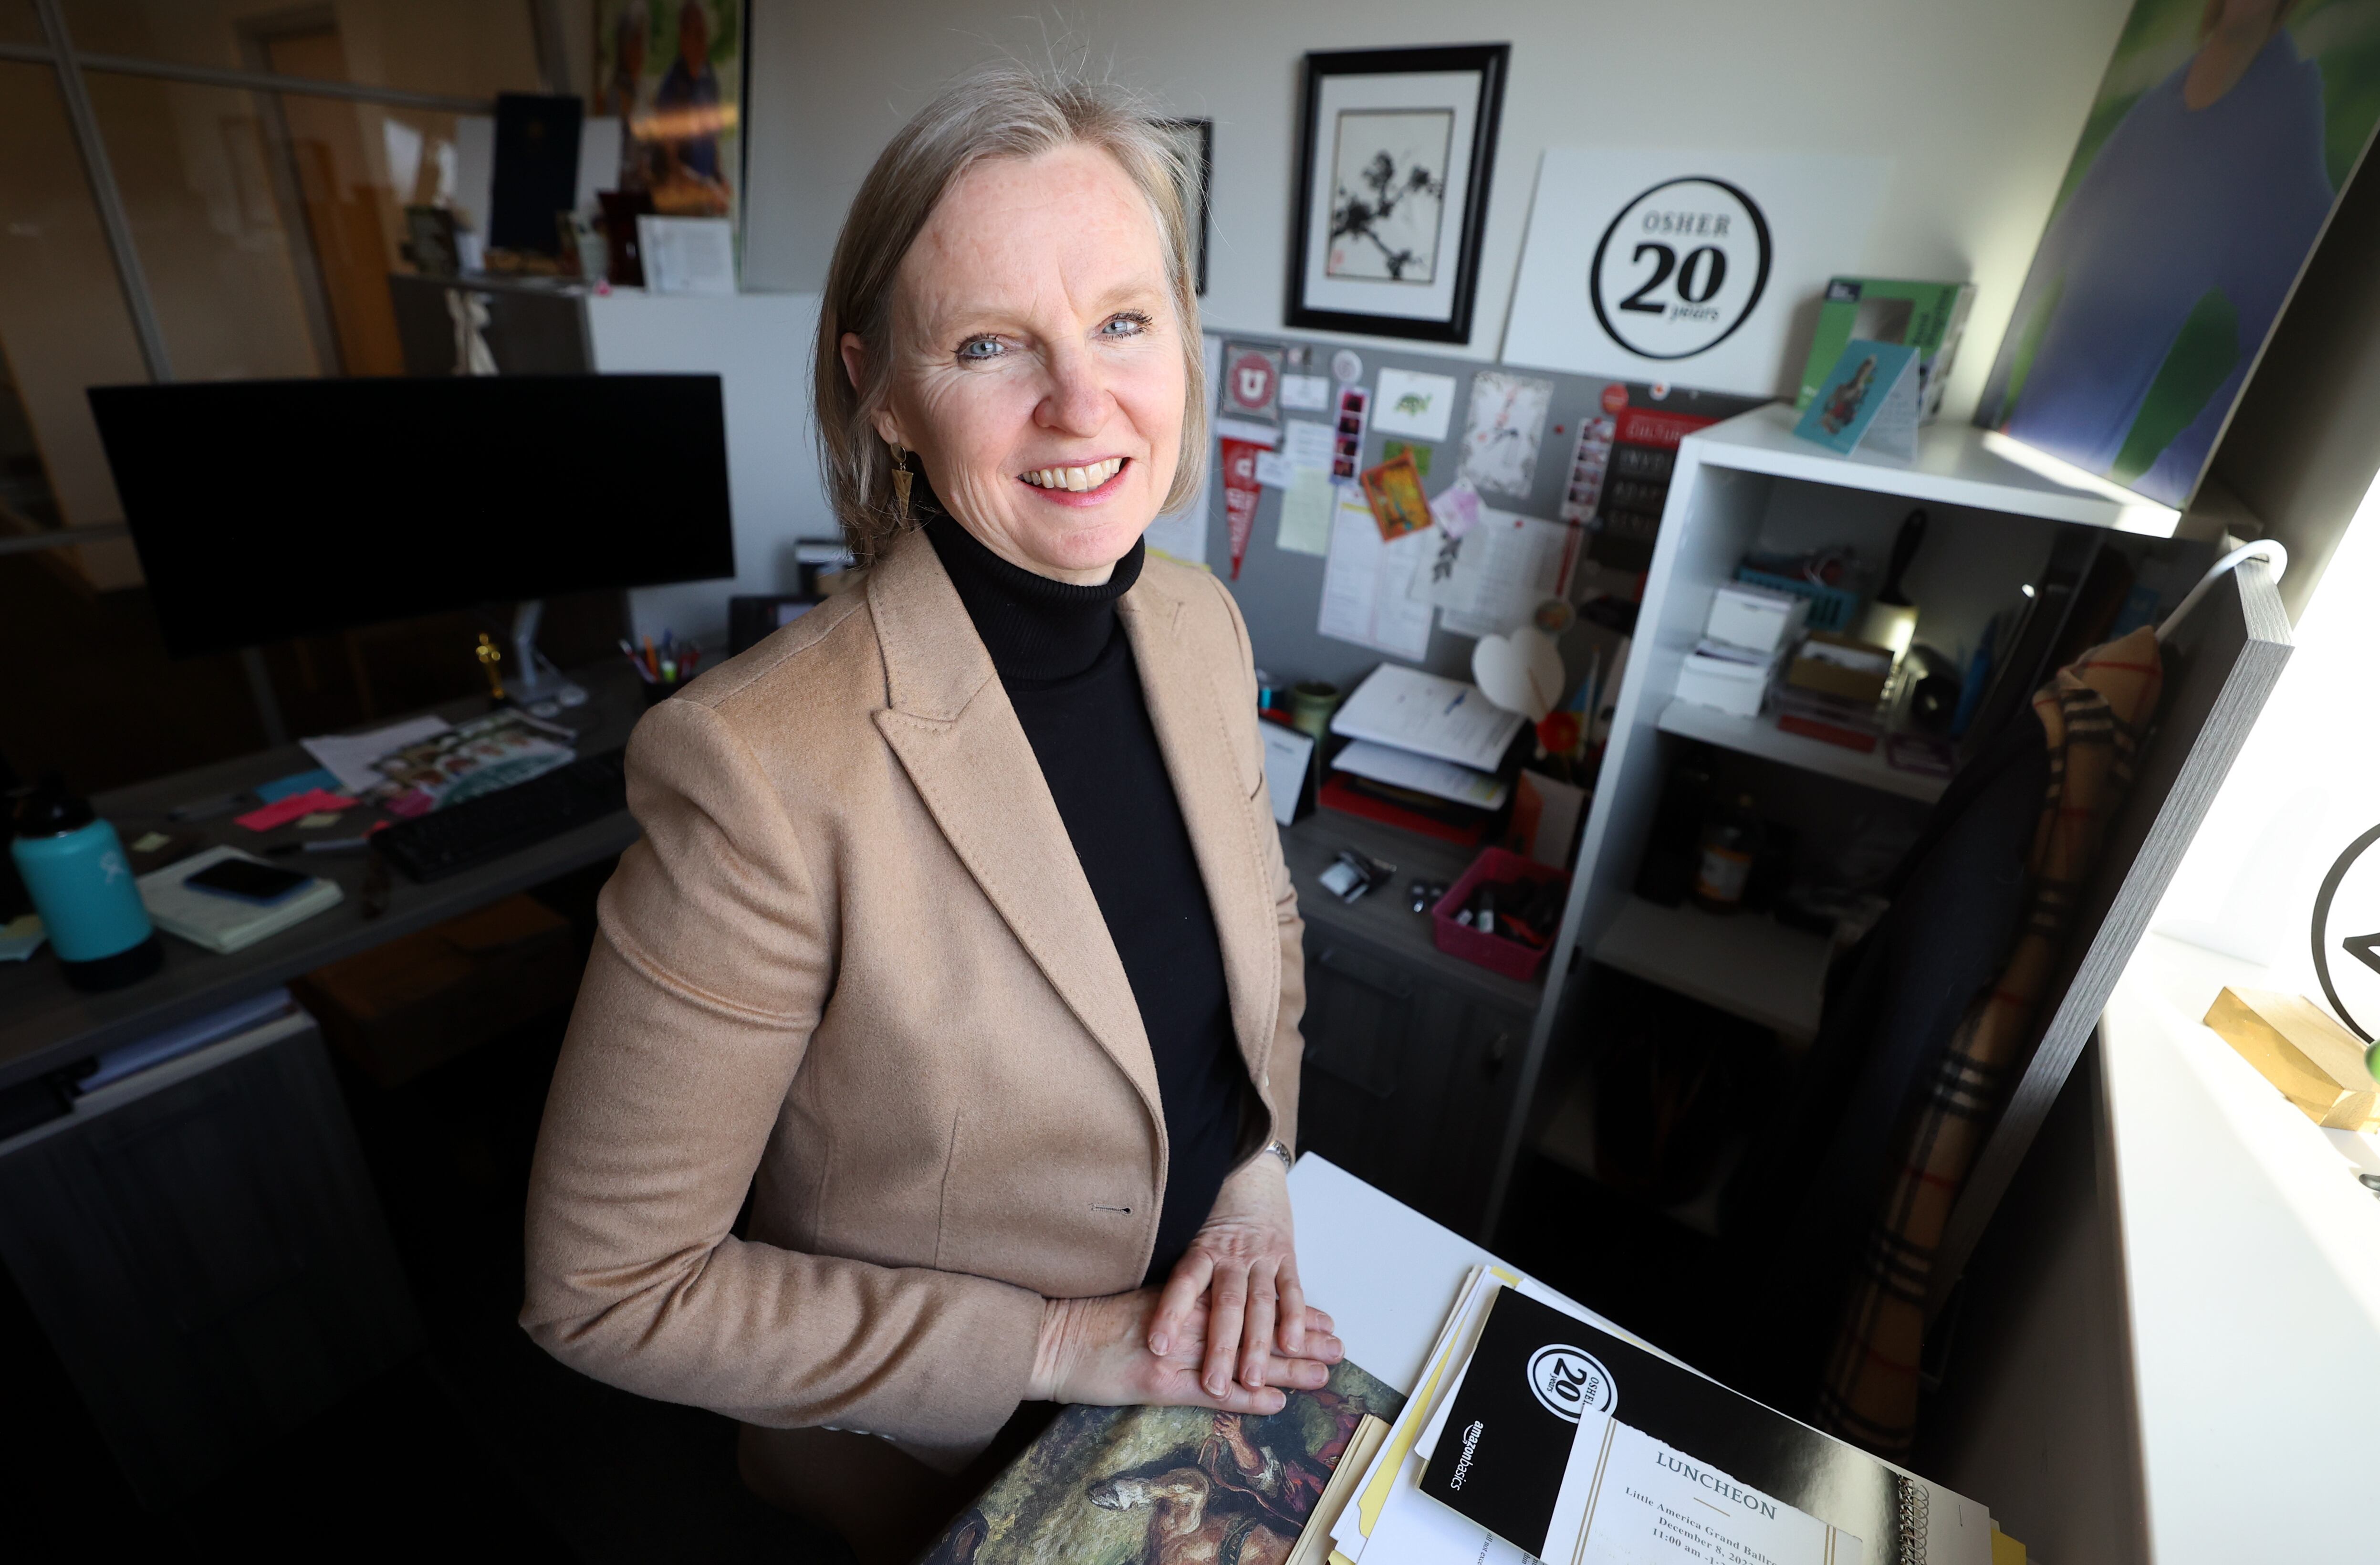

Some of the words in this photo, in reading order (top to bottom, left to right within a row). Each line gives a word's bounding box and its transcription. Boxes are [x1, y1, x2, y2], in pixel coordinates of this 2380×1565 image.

[1643, 210, 1731, 237] OSHER
[1619, 243, 1727, 314] 20
[1668, 305, 1720, 324] years
[1547, 1373, 1557, 1393] years
[1554, 1358, 1587, 1402] 20
[1451, 1420, 1483, 1491] amazonbasics
[1656, 1451, 1777, 1520] LUNCHEON
[1625, 1487, 1654, 1506] Little
[1657, 1503, 1701, 1530] America
[1705, 1526, 1740, 1550] Grand
[1659, 1516, 1712, 1548] December
[1715, 1545, 1725, 1557] 8,
[1728, 1552, 1753, 1565] 202
[1482, 1541, 1490, 1553] not
[1652, 1528, 1681, 1547] 11:00
[1684, 1545, 1701, 1558] am
